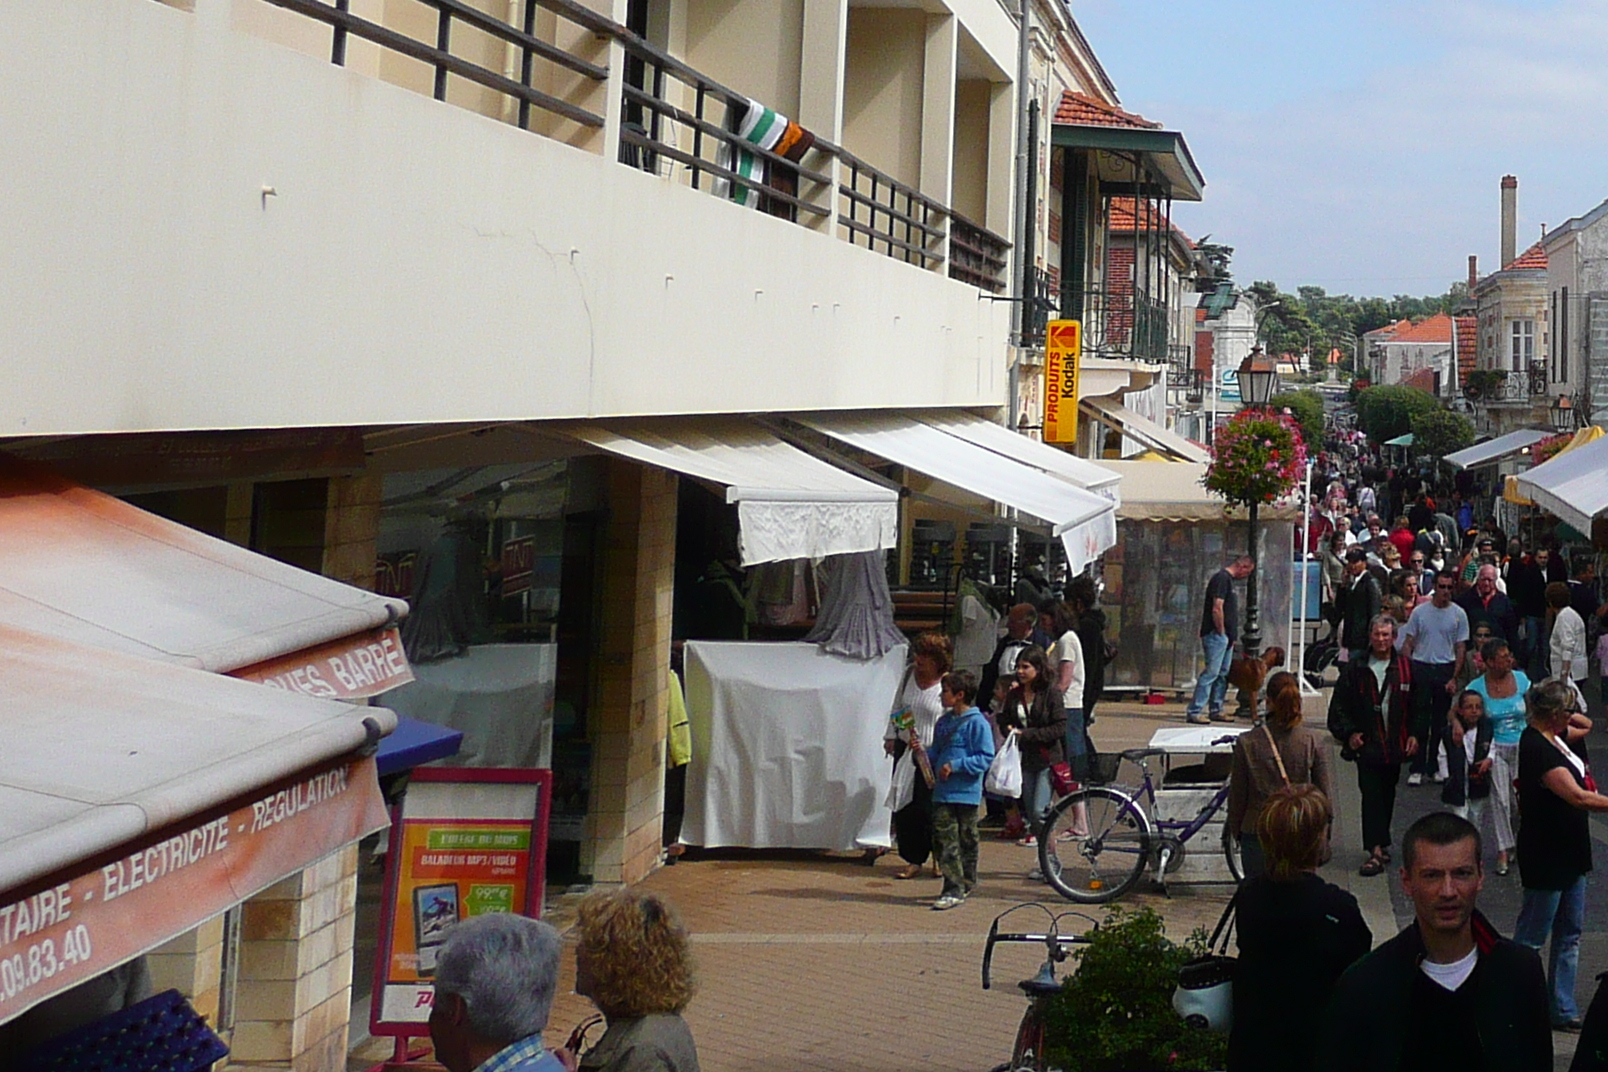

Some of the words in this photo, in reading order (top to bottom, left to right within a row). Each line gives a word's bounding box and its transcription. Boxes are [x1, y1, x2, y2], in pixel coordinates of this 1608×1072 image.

[1047, 351, 1061, 423] PRODUITS
[1061, 352, 1076, 399] Kodak
[0, 883, 72, 946] TAIRE
